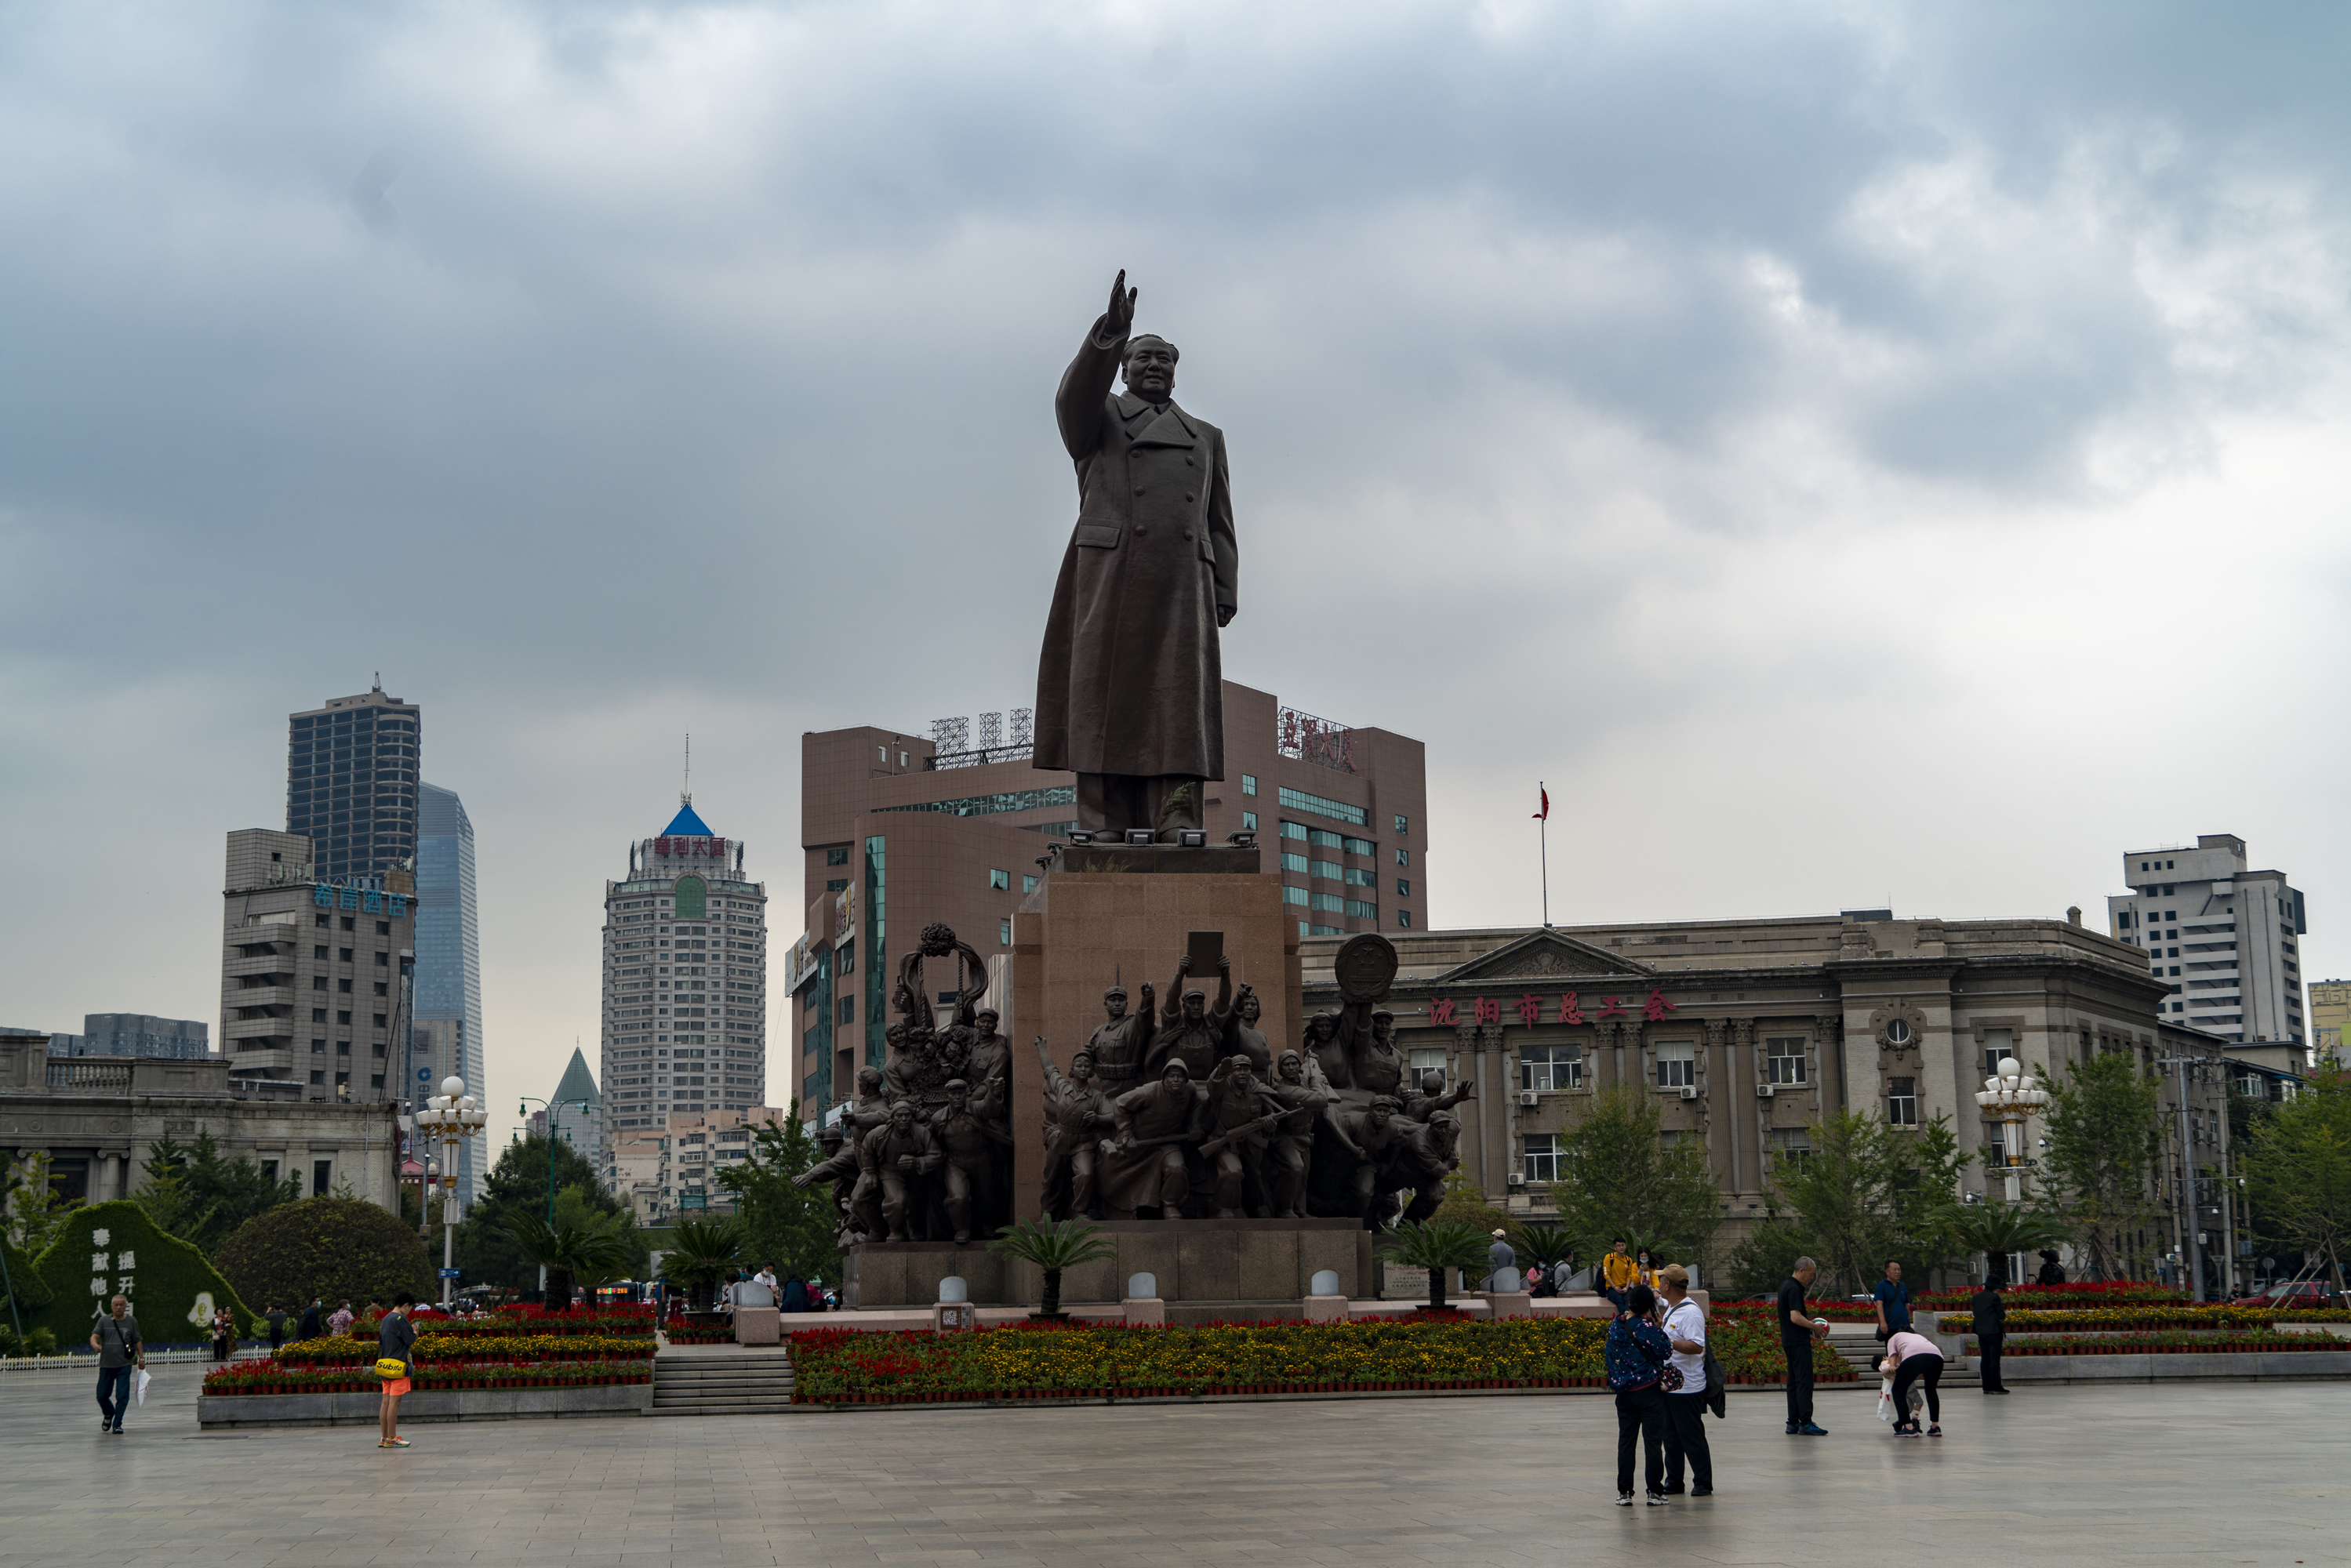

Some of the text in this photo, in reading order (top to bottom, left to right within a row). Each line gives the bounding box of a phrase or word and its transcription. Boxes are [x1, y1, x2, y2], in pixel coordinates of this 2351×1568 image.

[314, 883, 407, 917] 希岸酒店
[1428, 987, 1677, 1030] 沈阳市总工会
[417, 1084, 430, 1141] 中国建行
[89, 1228, 111, 1319] 奉献他人
